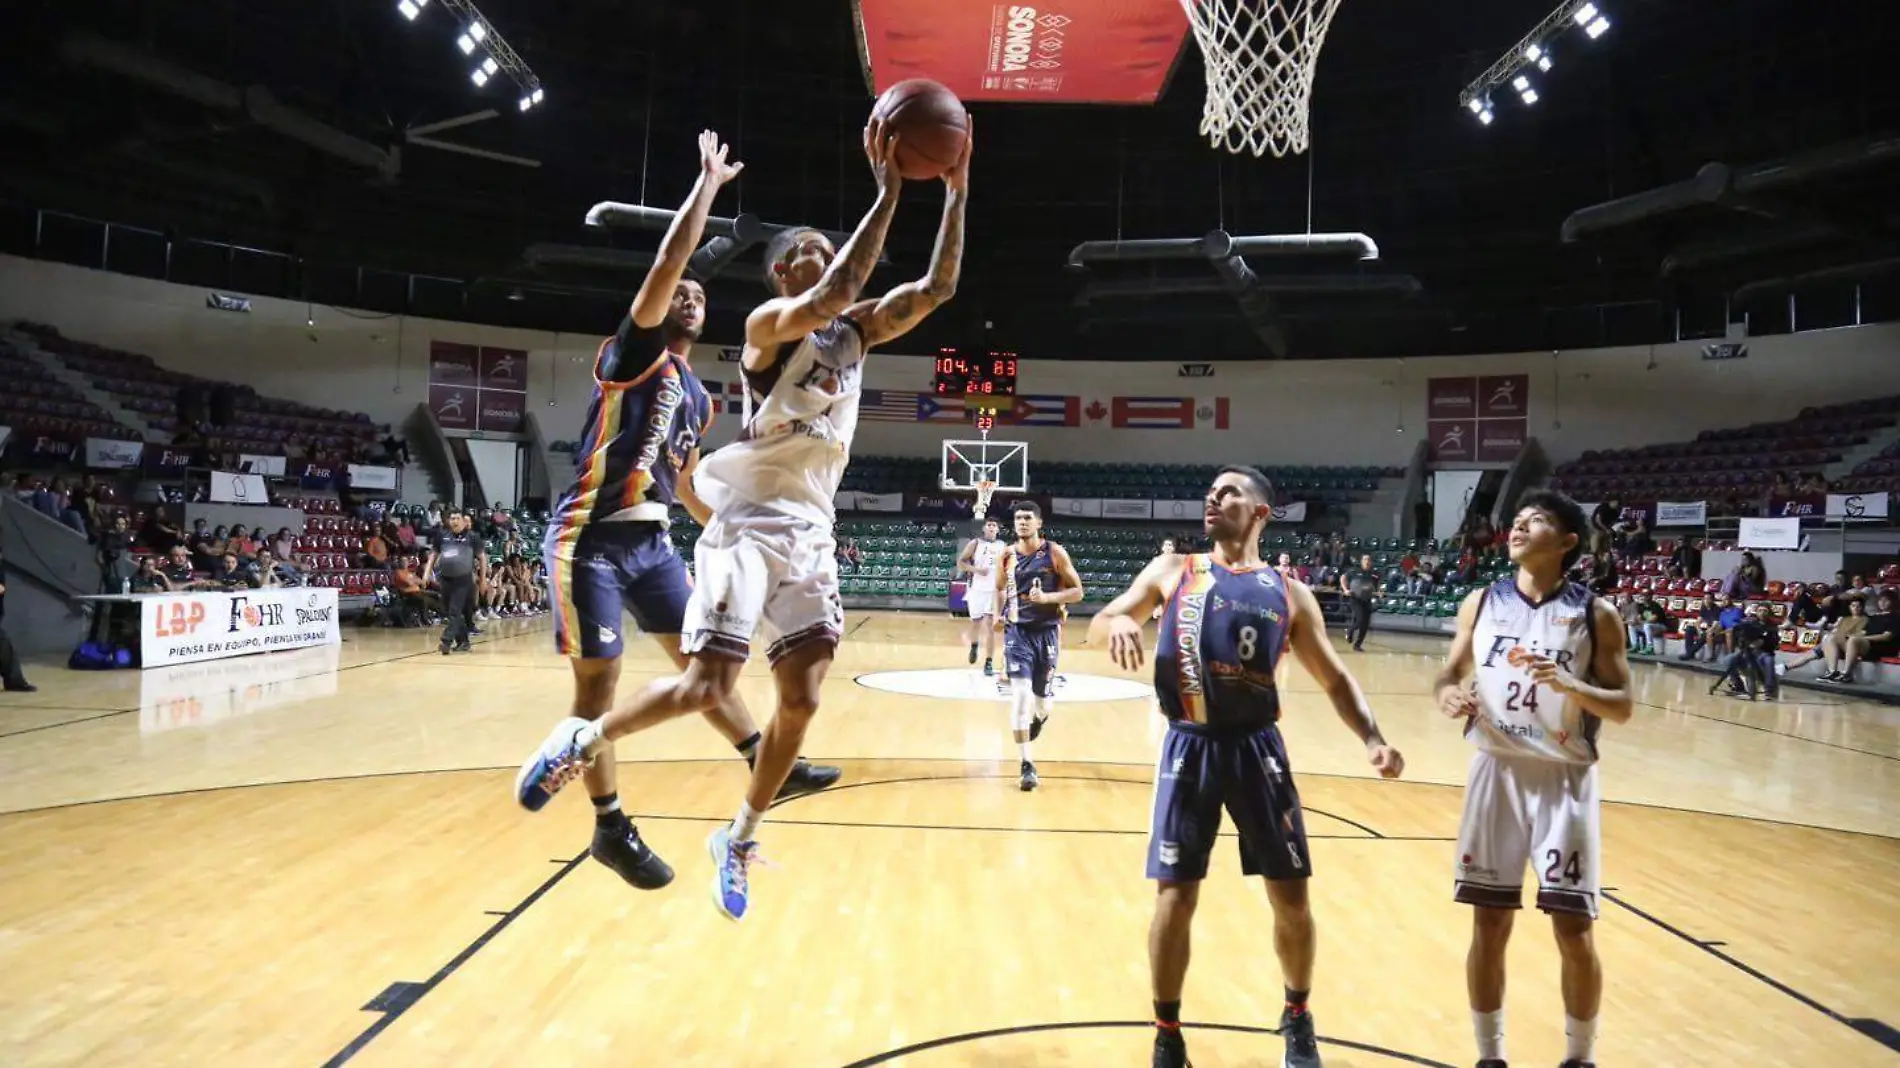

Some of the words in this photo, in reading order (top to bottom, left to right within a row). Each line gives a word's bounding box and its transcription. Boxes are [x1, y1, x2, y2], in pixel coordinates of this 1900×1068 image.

[1003, 5, 1037, 72] SONORA
[994, 360, 1016, 376] 83
[966, 381, 993, 393] 2:18
[978, 417, 993, 429] 23
[155, 602, 206, 638] LBP
[227, 596, 285, 633] FOHR
[168, 643, 205, 657] PIENSA
[207, 642, 222, 652] EN
[1178, 593, 1204, 695] NAVOJOA
[1237, 625, 1258, 661] 8
[1506, 681, 1539, 713] 24
[1545, 848, 1582, 885] 24
